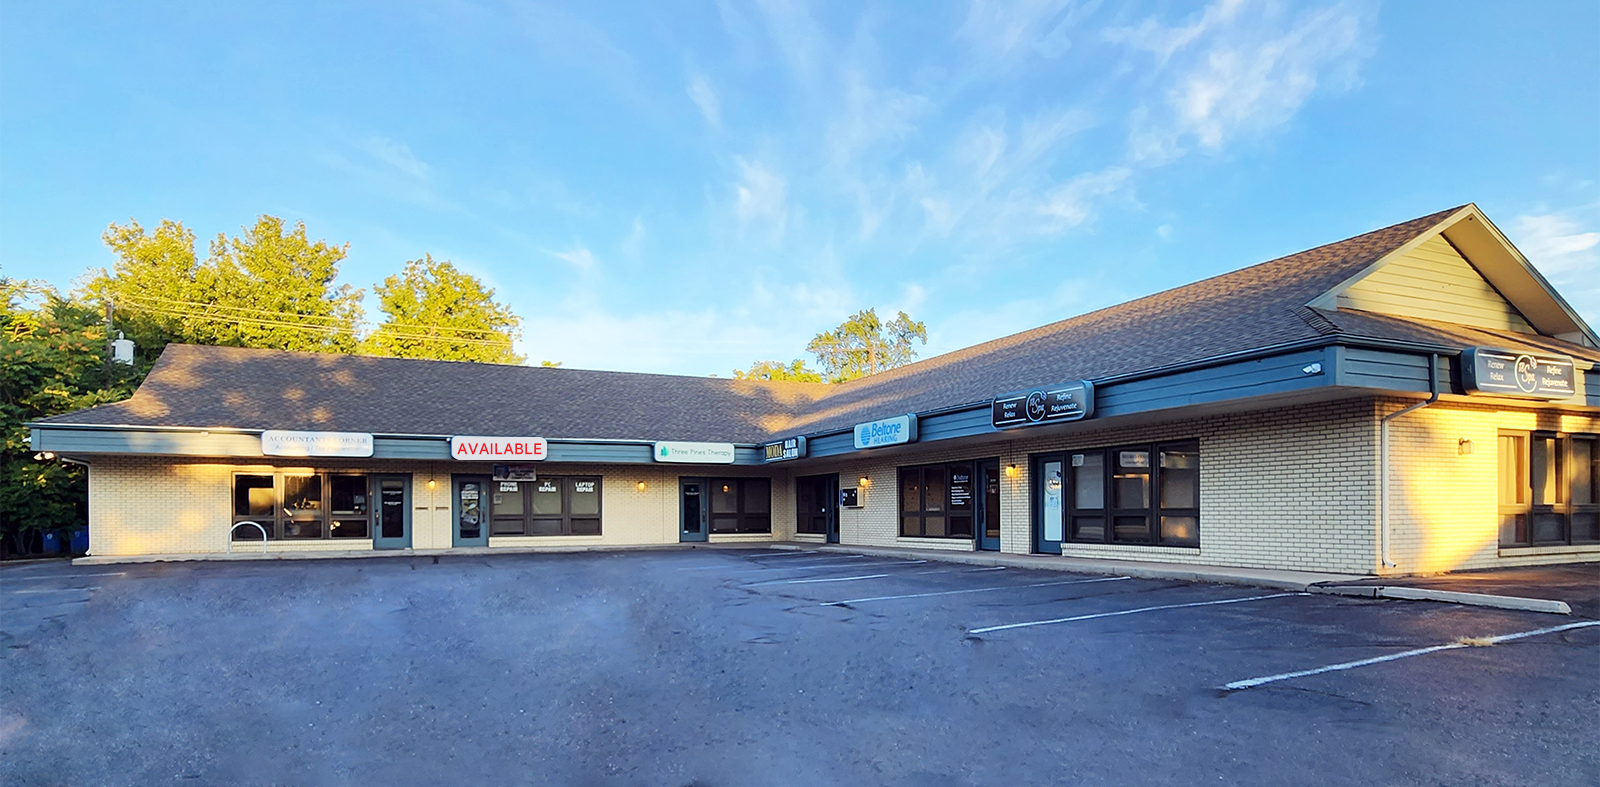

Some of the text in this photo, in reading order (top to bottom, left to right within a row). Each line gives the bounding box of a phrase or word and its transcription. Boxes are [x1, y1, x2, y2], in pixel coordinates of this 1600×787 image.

[1488, 360, 1505, 369] Renew
[1546, 366, 1562, 376] Refine
[1490, 372, 1504, 381] Relax
[1541, 377, 1568, 387] Rejuvenate
[1056, 392, 1072, 401] Refine
[1051, 402, 1077, 412] Rejuvenate
[871, 422, 901, 437] Beltone
[874, 435, 898, 444] HEARING
[457, 442, 542, 455] AVAILABLE
[708, 449, 731, 457] Therapy
[765, 444, 783, 459] MODA
[783, 447, 798, 459] SALON
